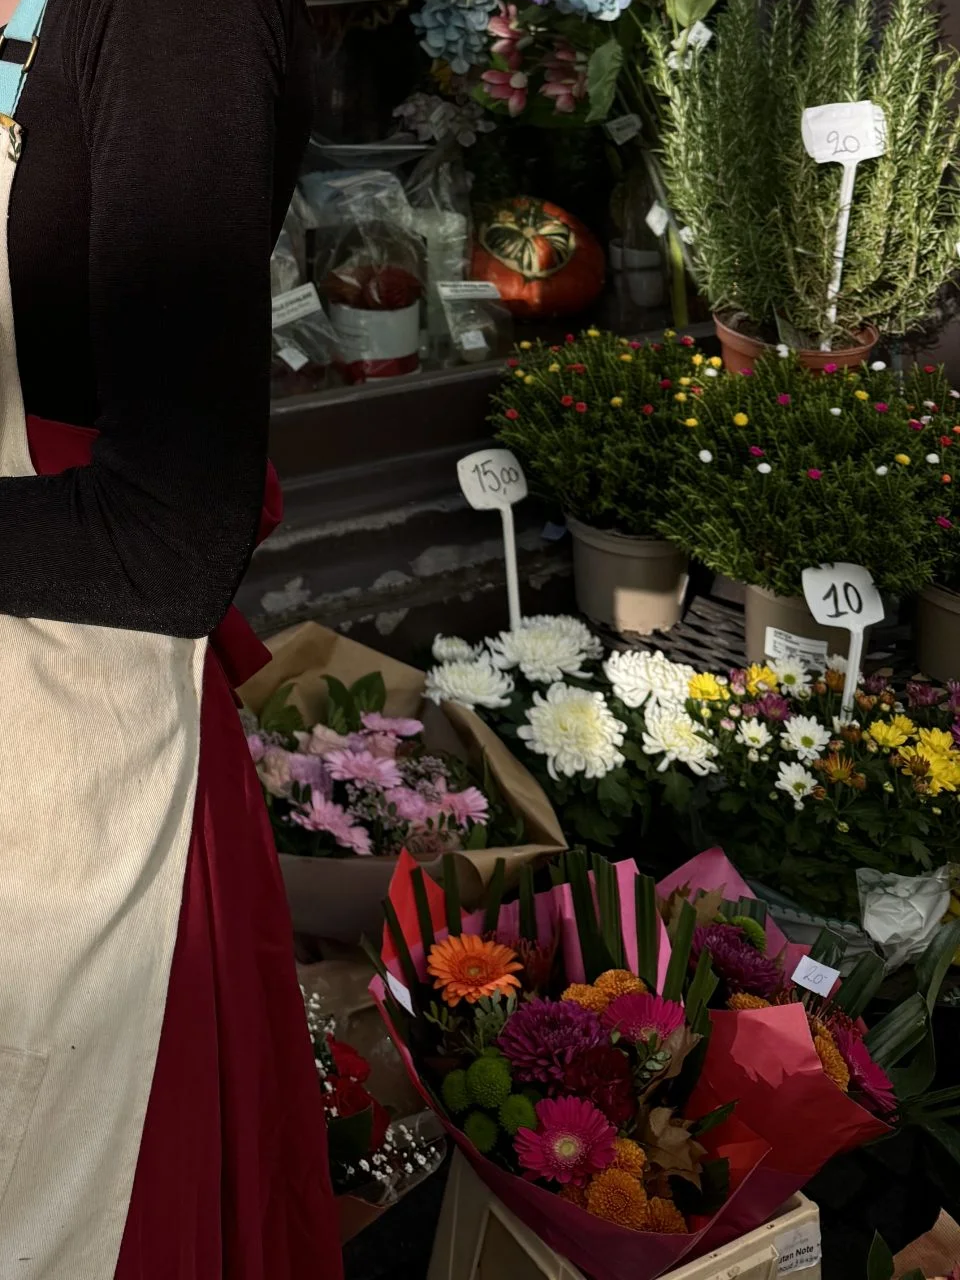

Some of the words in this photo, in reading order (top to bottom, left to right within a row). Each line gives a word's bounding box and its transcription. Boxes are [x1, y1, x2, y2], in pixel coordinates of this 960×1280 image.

[827, 130, 860, 156] 20
[472, 459, 519, 495] 15,00
[822, 582, 863, 618] 10
